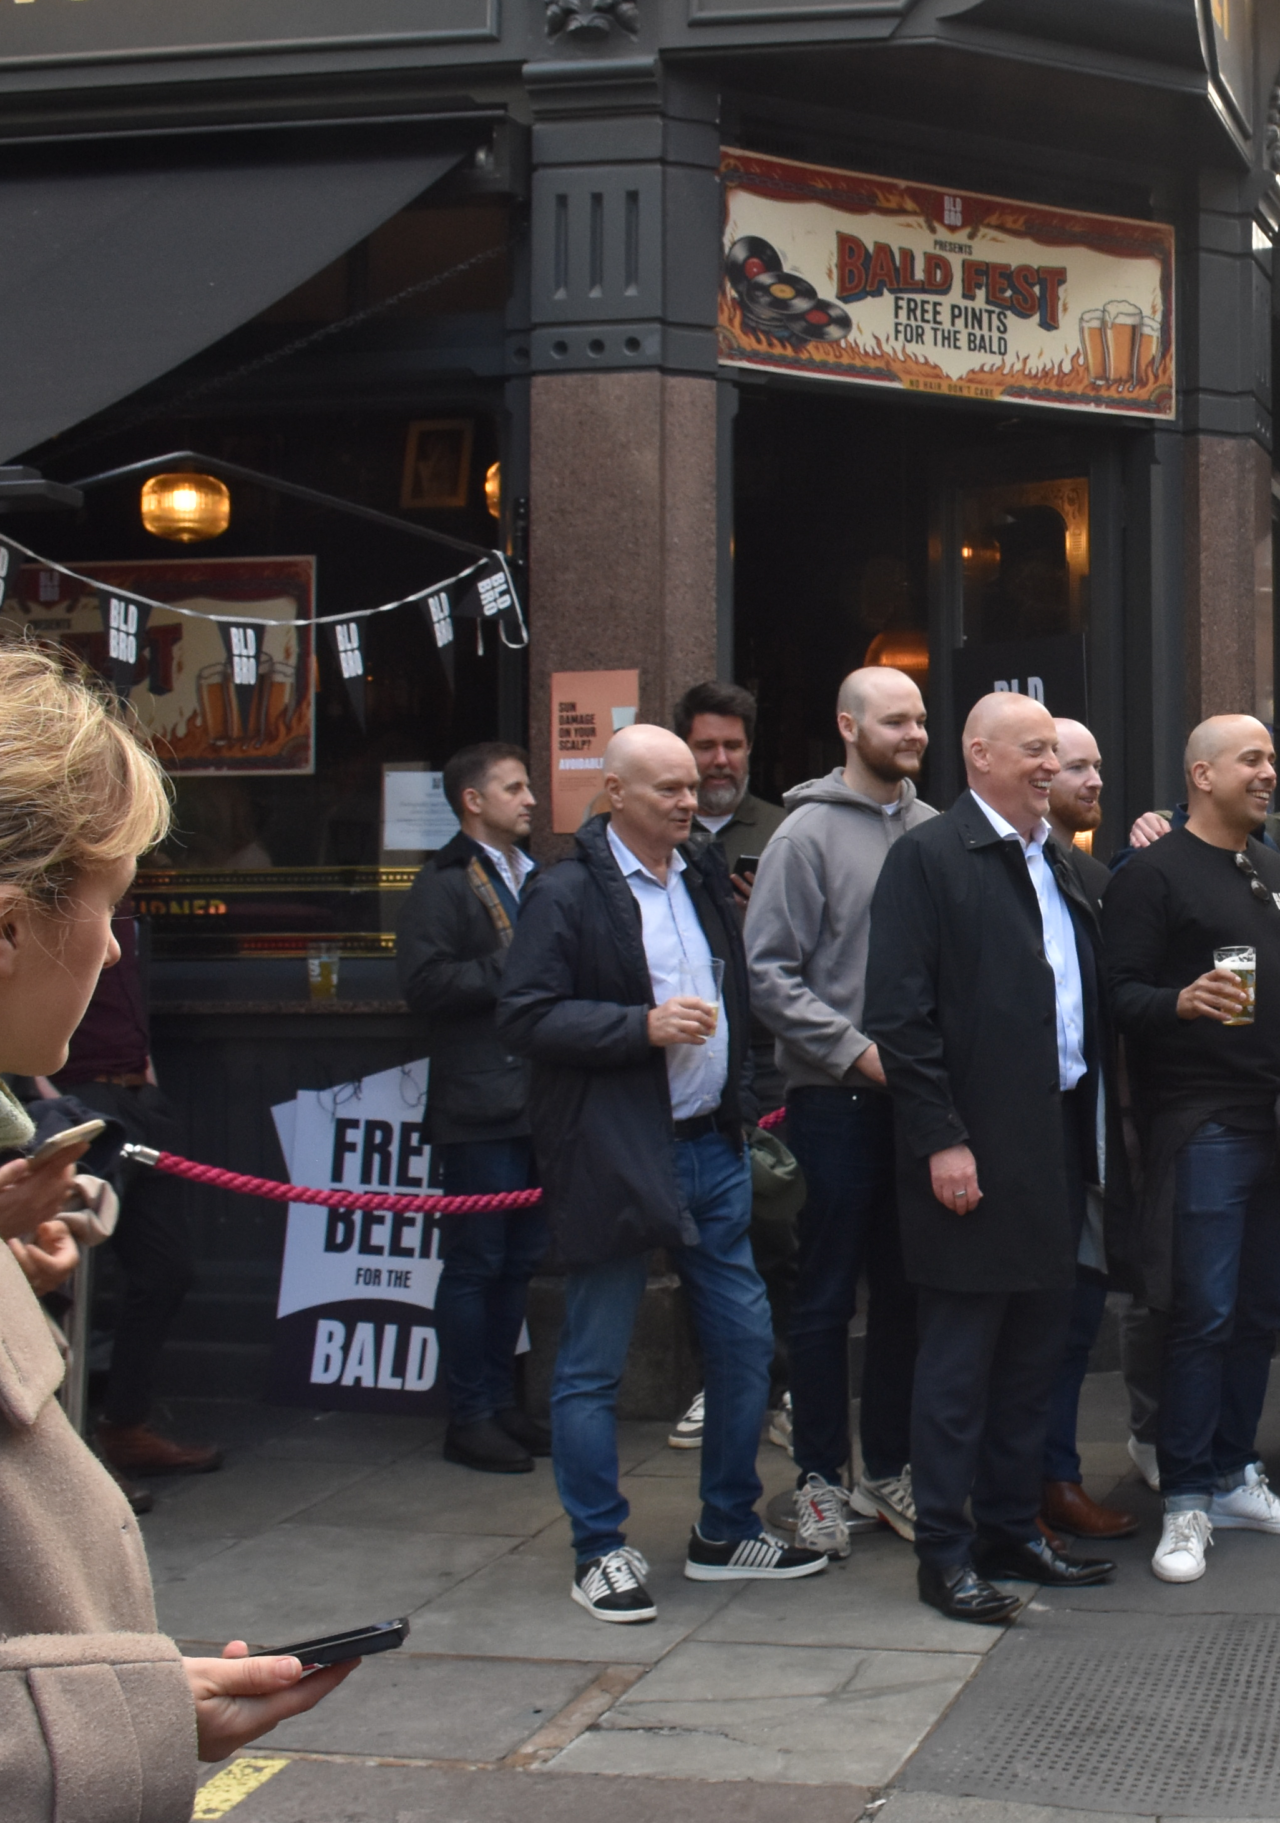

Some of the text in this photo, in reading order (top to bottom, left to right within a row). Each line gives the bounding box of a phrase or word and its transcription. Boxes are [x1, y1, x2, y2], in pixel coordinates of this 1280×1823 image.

[934, 239, 973, 256] PRESENTS
[836, 231, 1068, 332] BALD FEST
[894, 296, 1008, 335] FREE PINTS
[894, 322, 1008, 356] FOR THE BALD
[477, 578, 499, 616] BRO
[490, 571, 512, 610] BLD
[110, 598, 138, 634] BLD
[428, 592, 450, 622] BLD
[109, 628, 137, 665] BRO
[229, 627, 256, 656] BLD
[335, 622, 359, 652] BLD
[434, 617, 454, 647] BRO
[232, 656, 257, 685] BRO
[339, 649, 363, 679] BRO
[558, 702, 576, 713] SUN
[558, 714, 596, 726] DAMAGE
[558, 726, 596, 738] ON YOUR
[558, 739, 592, 751] SCALP?
[355, 1268, 412, 1289] FOR THE
[310, 1319, 440, 1392] BALD
